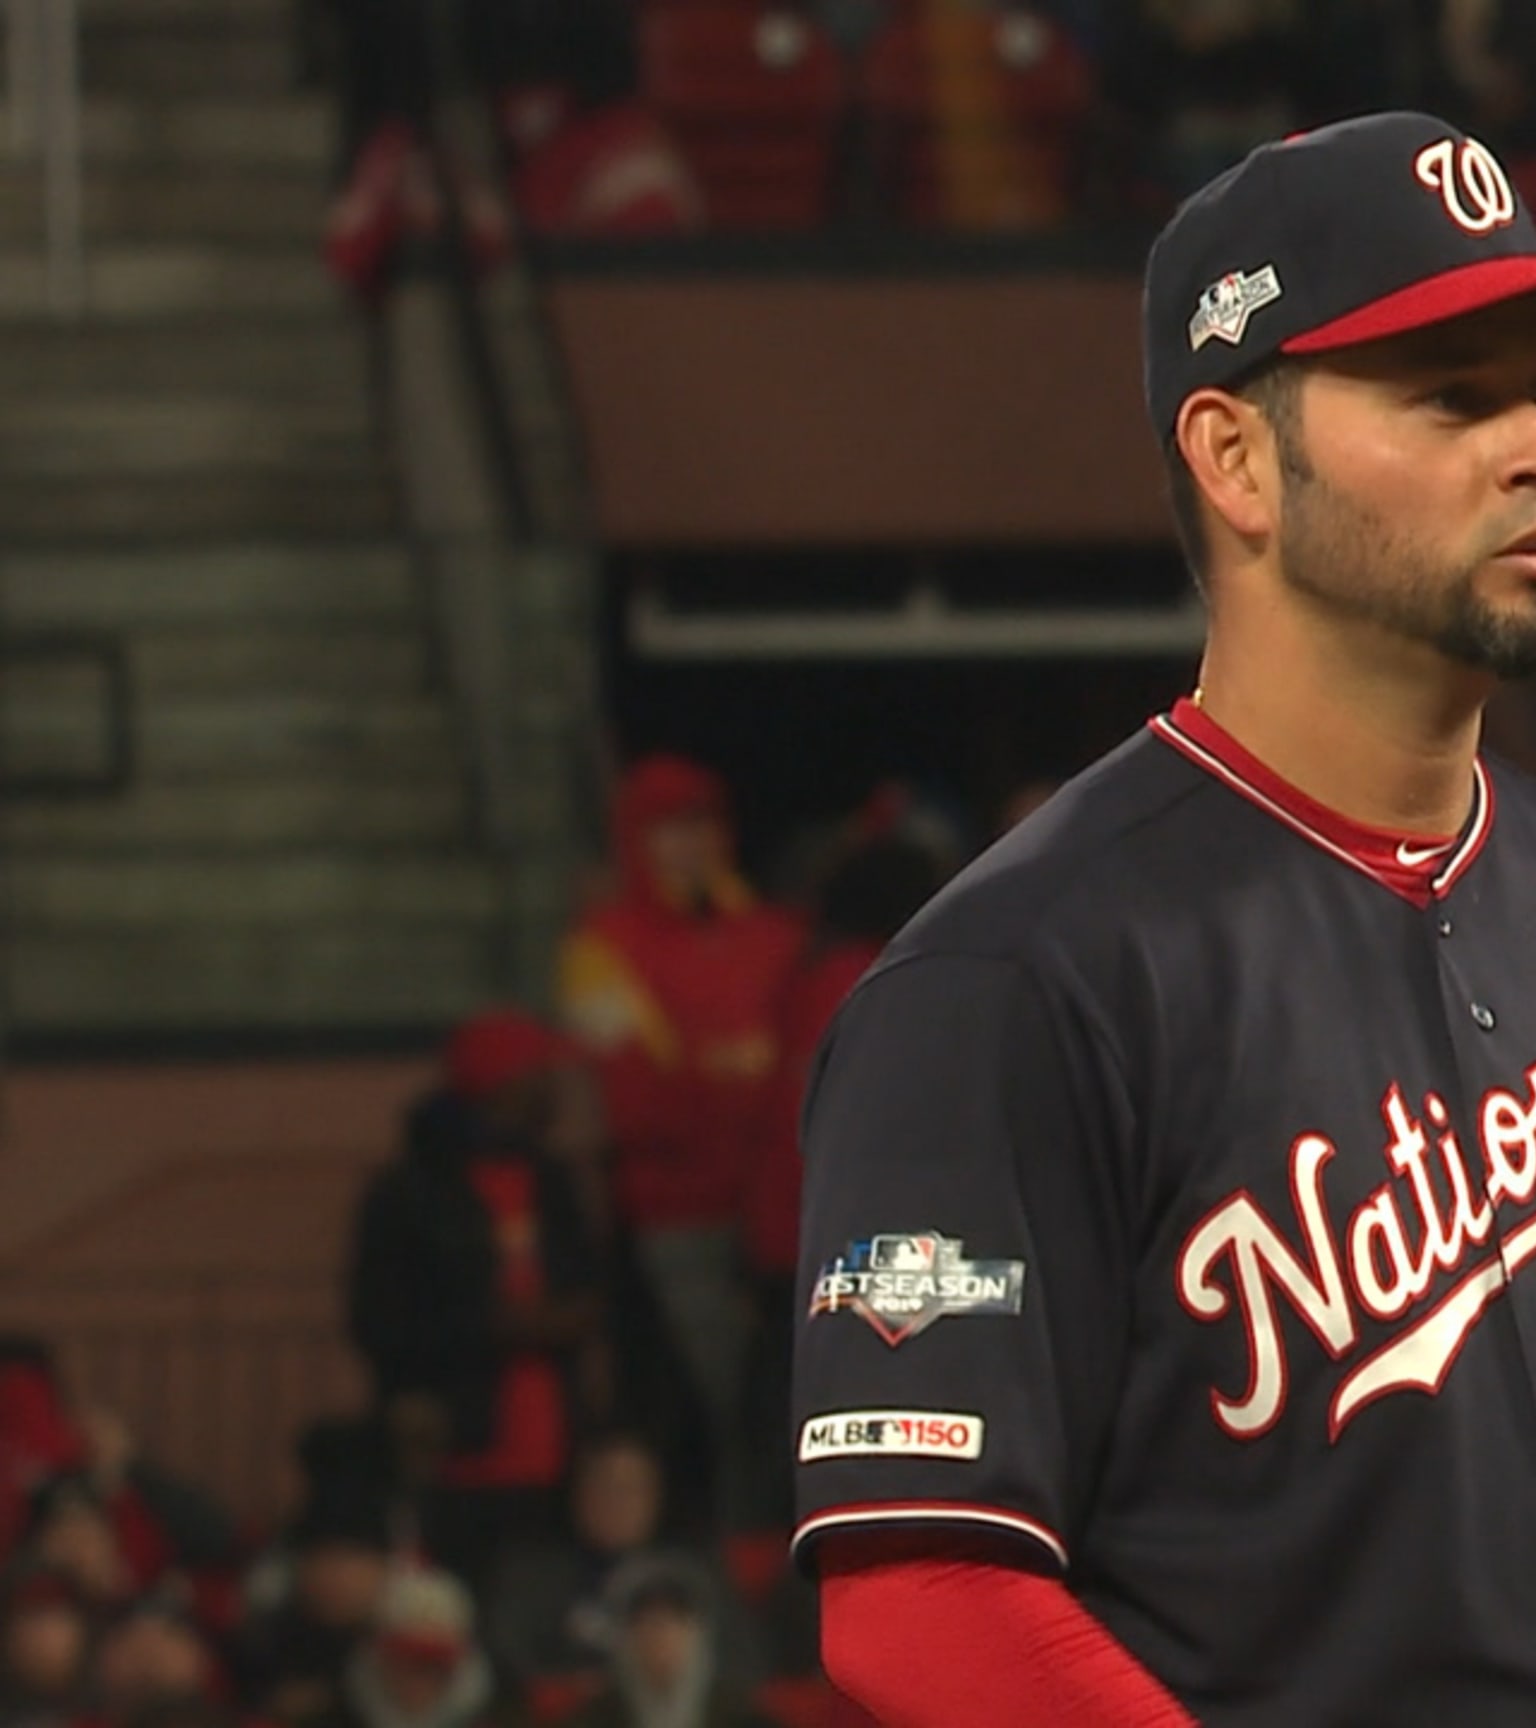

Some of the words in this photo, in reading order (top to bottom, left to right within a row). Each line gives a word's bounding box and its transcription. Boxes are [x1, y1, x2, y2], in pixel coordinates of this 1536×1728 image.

[1411, 137, 1516, 235] W
[820, 1272, 1007, 1300] OSTSEASON
[808, 1419, 863, 1450] MLB
[917, 1419, 969, 1449] 150
